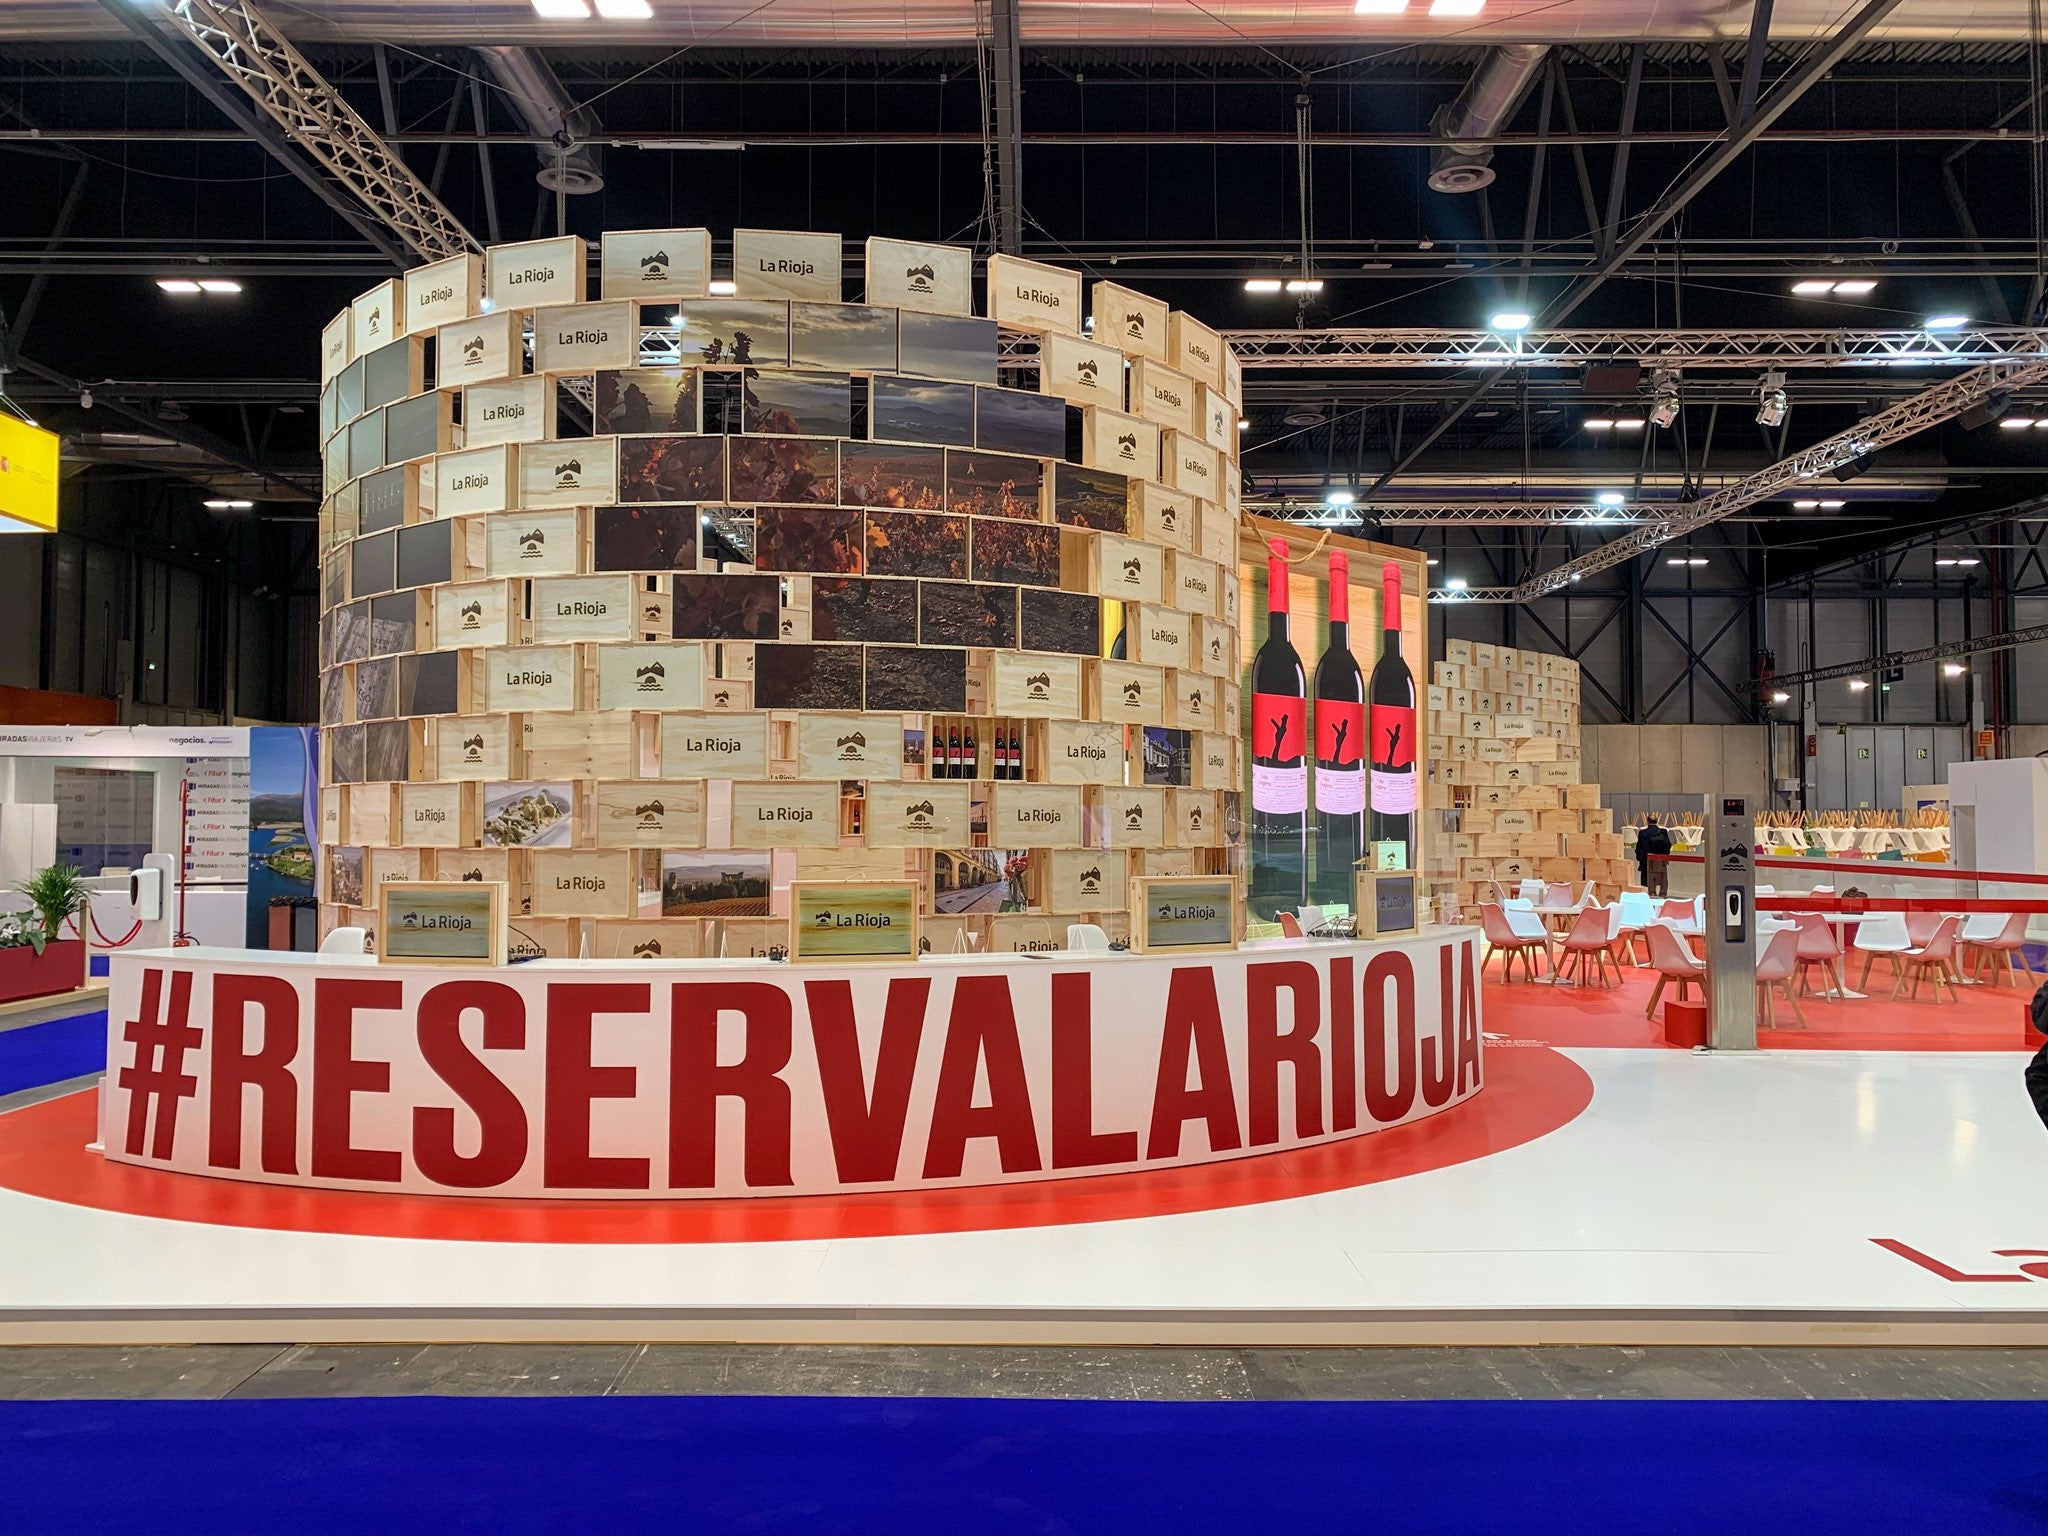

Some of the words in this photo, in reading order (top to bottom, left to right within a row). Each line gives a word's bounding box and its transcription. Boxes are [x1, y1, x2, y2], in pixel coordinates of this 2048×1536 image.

[509, 272, 522, 285] La
[525, 267, 554, 283] Rioja
[760, 259, 775, 272] La
[779, 260, 813, 277] Rioja
[420, 293, 430, 306] La
[431, 286, 453, 303] Rioja
[1017, 286, 1029, 299] La
[1031, 289, 1060, 308] Rioja
[559, 332, 573, 345] La
[576, 329, 608, 344] Rioja
[1188, 341, 1196, 355] La
[1195, 345, 1210, 363] Rioja
[1154, 386, 1163, 400] La
[1163, 389, 1181, 407] Rioja
[483, 408, 496, 421] La
[497, 403, 525, 419] Rioja
[1185, 457, 1193, 471] La
[1193, 460, 1208, 477] Rioja
[452, 478, 463, 491] La
[464, 474, 489, 489] Rioja
[1185, 576, 1192, 588] La
[1192, 579, 1207, 593] Rioja
[557, 603, 572, 616] La
[574, 601, 606, 617] Rioja
[1151, 628, 1160, 641] La
[1161, 630, 1178, 645] Rioja
[507, 673, 520, 686] La
[522, 671, 552, 686] Rioja
[687, 738, 703, 751] La
[705, 738, 741, 754] Rioja
[1067, 745, 1079, 758] La
[1080, 745, 1106, 761] Rioja
[415, 809, 424, 822] La
[425, 808, 445, 824] Rioja
[758, 807, 773, 820] La
[776, 807, 812, 823] Rioja
[1018, 809, 1030, 821] La
[1033, 809, 1061, 824] Rioja
[557, 877, 571, 890] La
[573, 876, 606, 892] Rioja
[836, 914, 852, 927] La
[855, 913, 890, 929] Rioja
[1175, 906, 1186, 919] La
[1189, 905, 1216, 921] Rioja
[422, 915, 436, 929] La
[439, 915, 472, 932] Rioja
[118, 939, 1481, 1190] #RESERVALARIOJA
